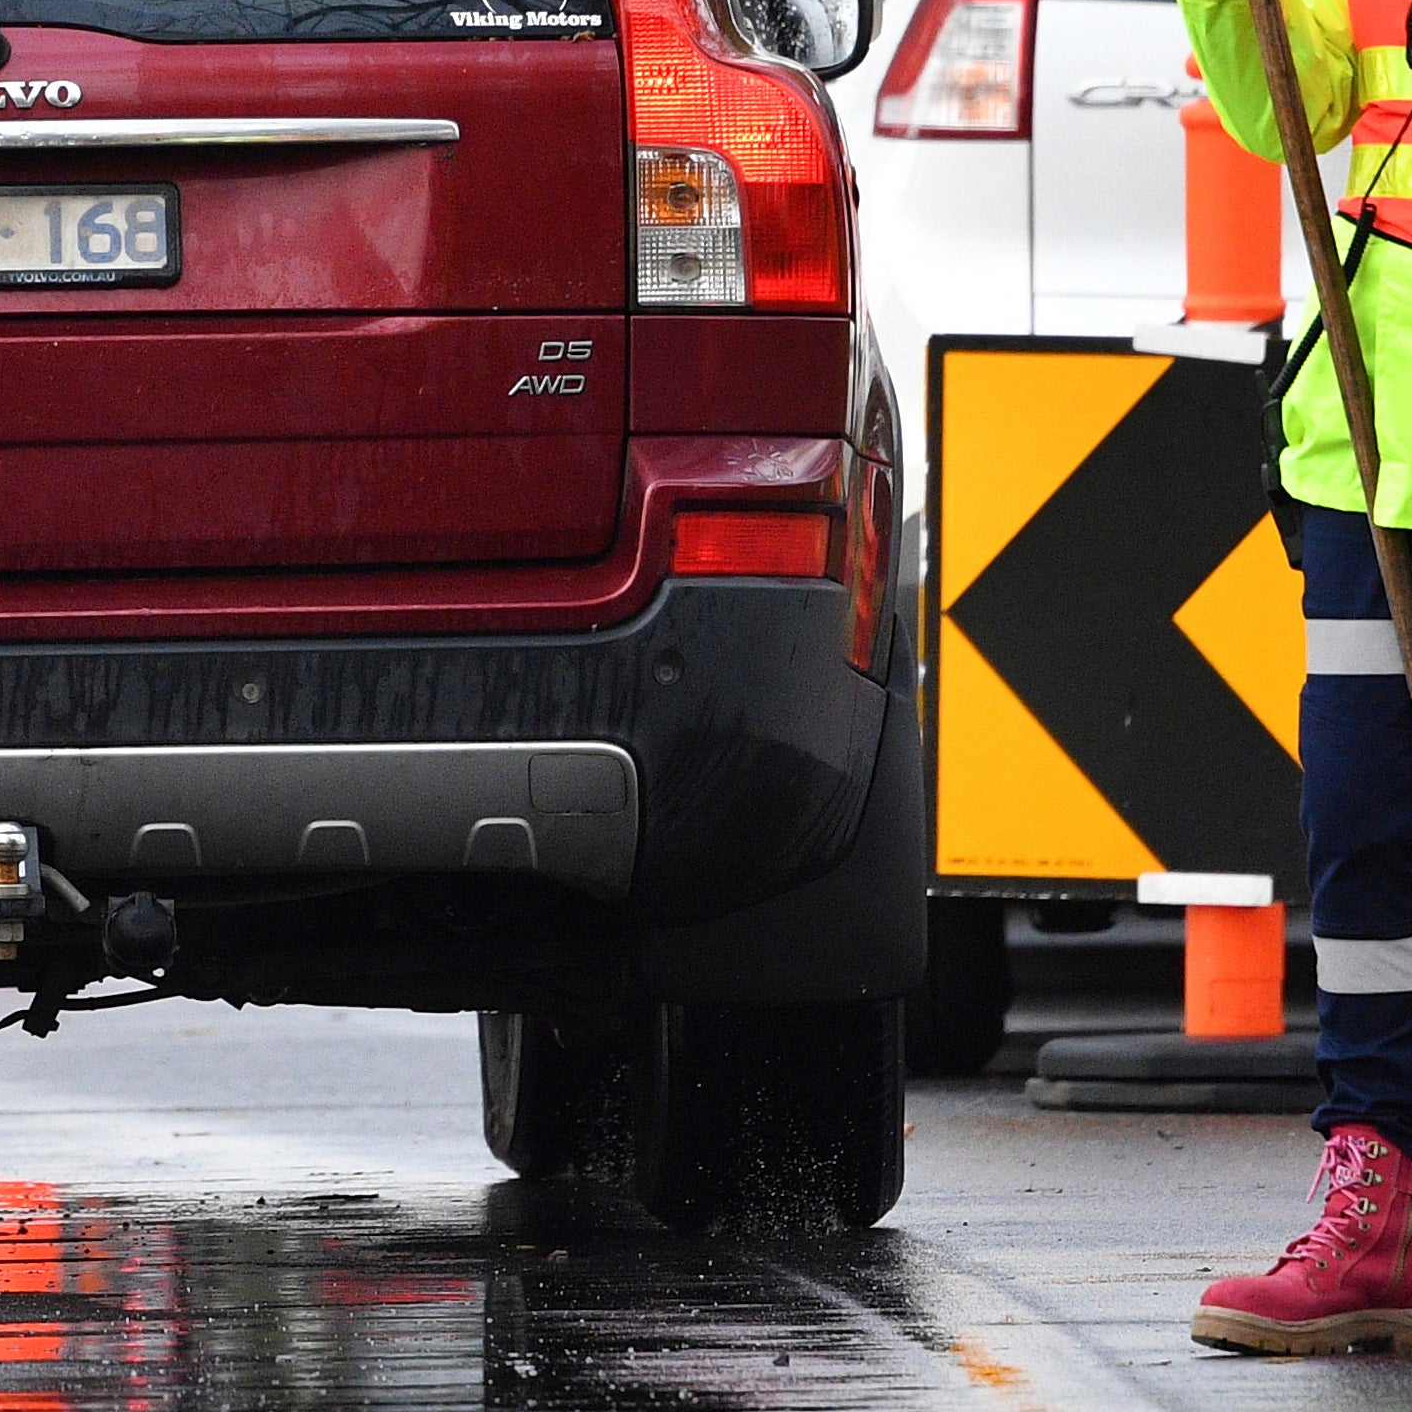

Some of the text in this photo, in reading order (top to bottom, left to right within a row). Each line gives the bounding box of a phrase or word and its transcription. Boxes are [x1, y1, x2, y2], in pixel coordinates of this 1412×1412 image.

[449, 10, 602, 30] Viking Motors
[43, 198, 168, 265] 168
[538, 340, 593, 361] D5
[508, 374, 585, 396] AWD
